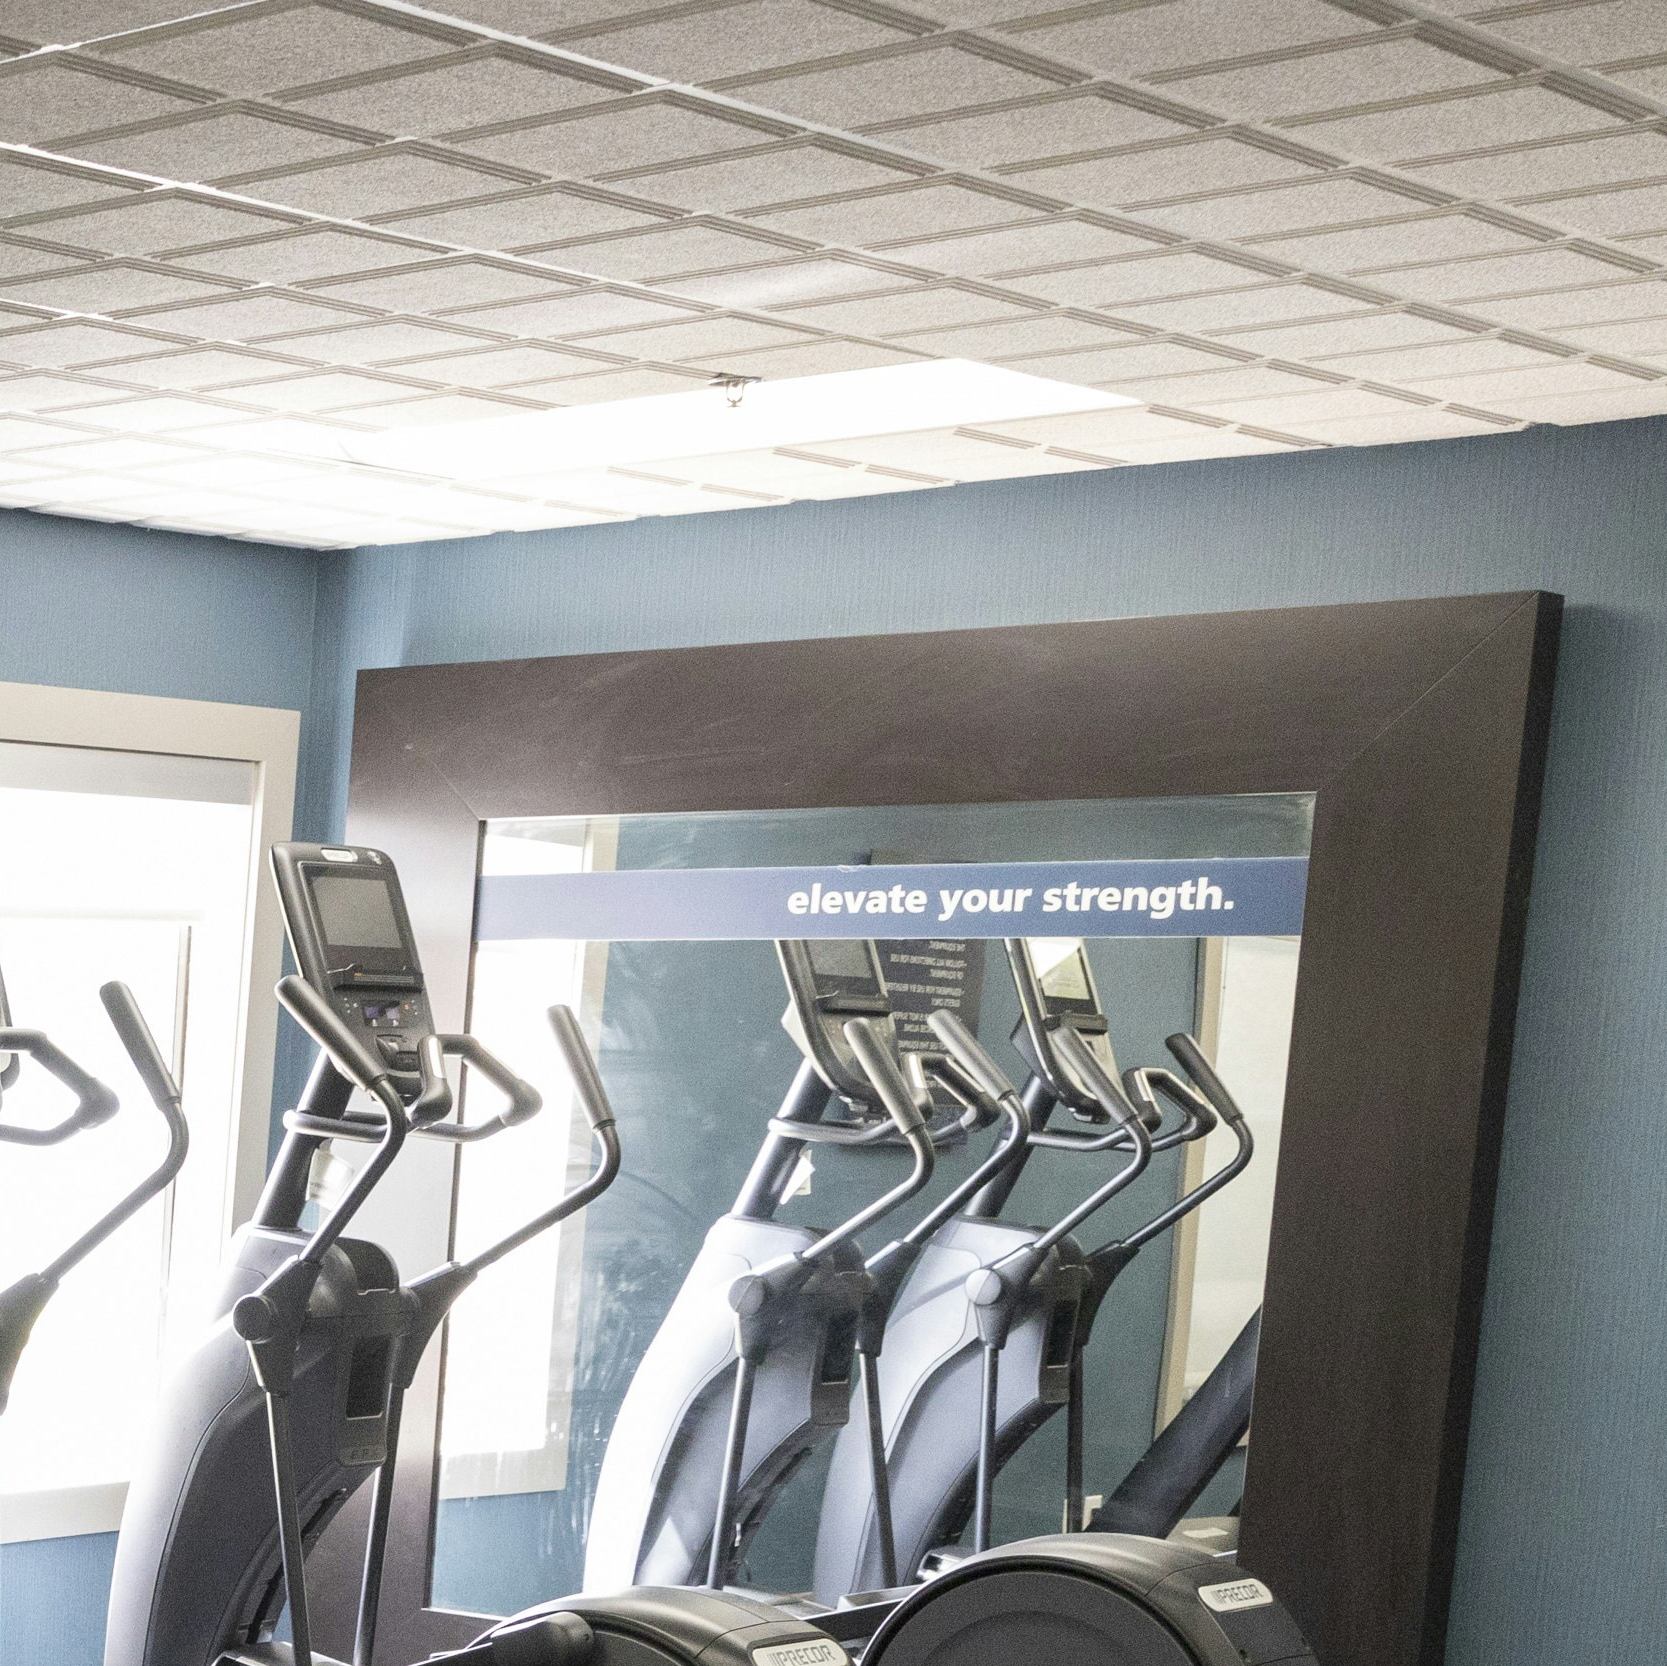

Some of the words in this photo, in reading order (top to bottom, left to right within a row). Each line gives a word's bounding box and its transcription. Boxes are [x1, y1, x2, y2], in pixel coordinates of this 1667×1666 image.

[787, 883, 928, 914] elevate
[938, 888, 1034, 921] your
[1042, 877, 1235, 919] strength.
[1216, 1584, 1265, 1604] PRECOR
